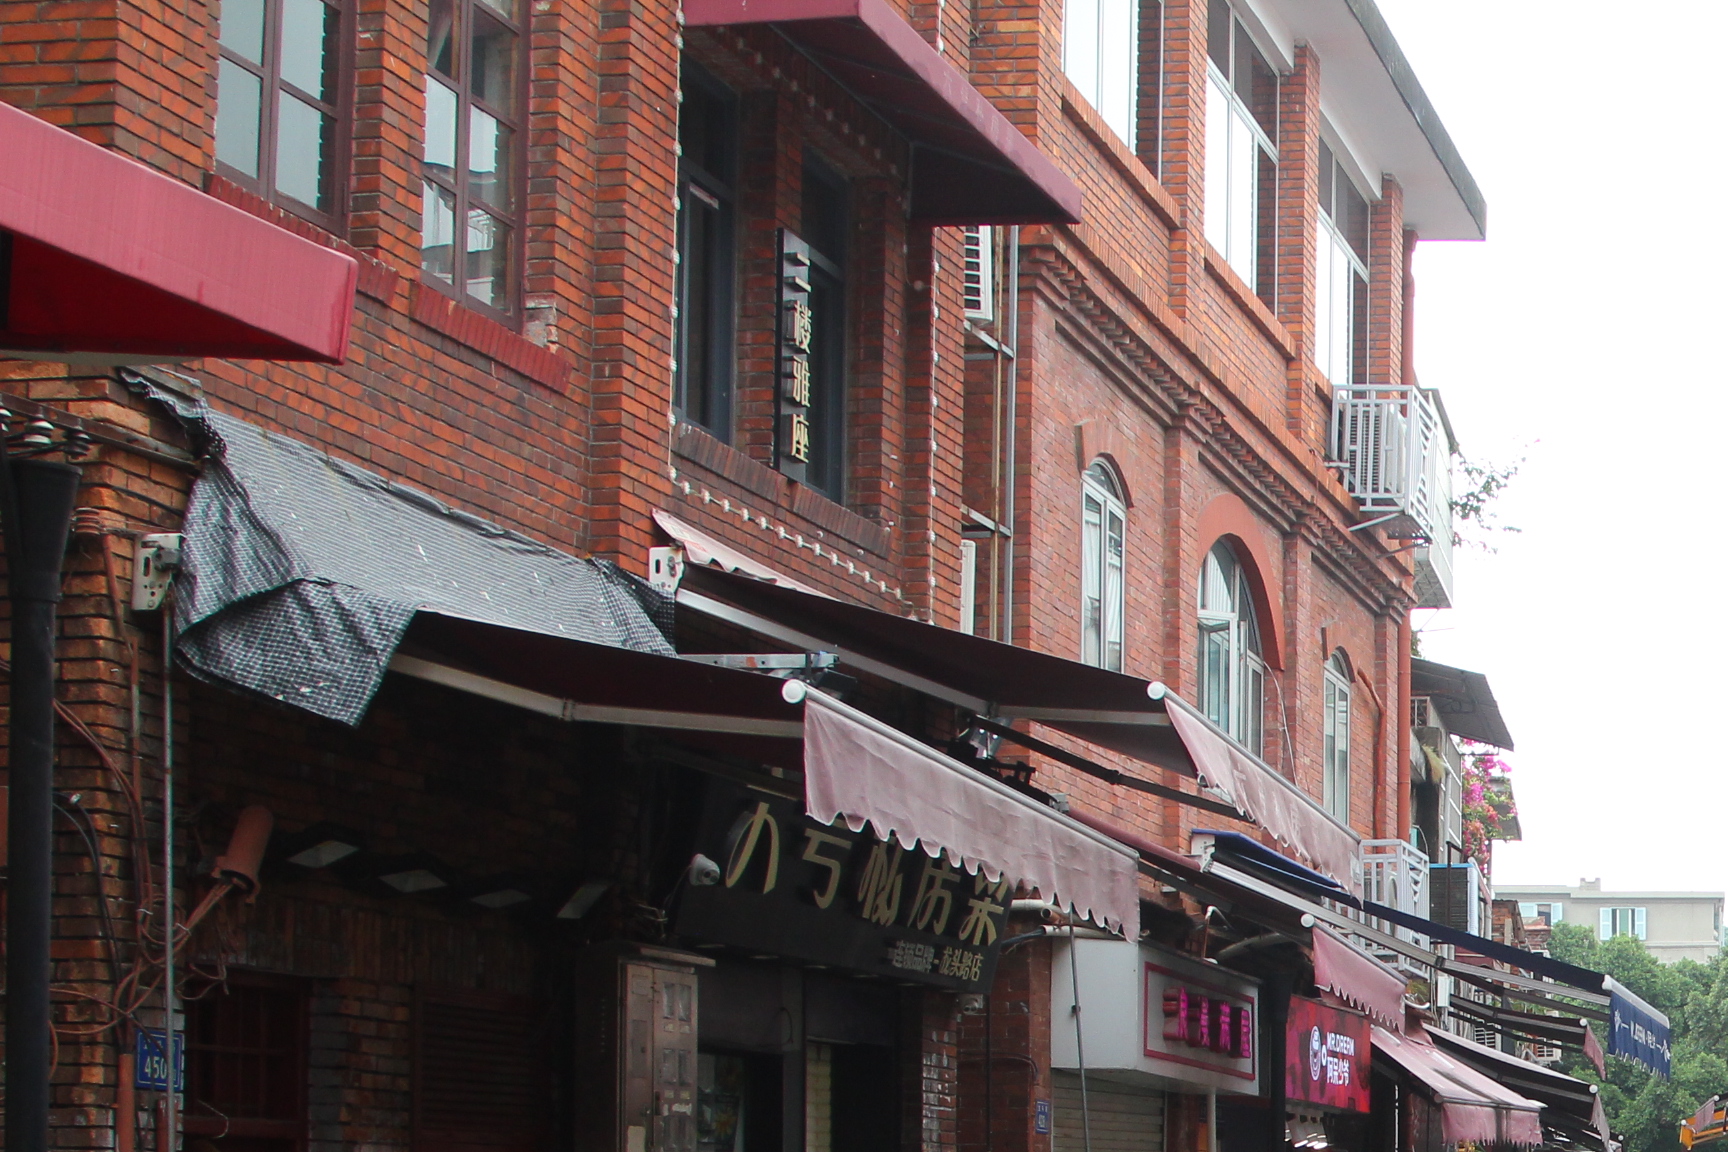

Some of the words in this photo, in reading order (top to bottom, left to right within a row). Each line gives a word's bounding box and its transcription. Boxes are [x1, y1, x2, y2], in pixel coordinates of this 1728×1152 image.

[791, 252, 812, 464] 二楼雅座
[1327, 1032, 1355, 1056] MR.DREAM
